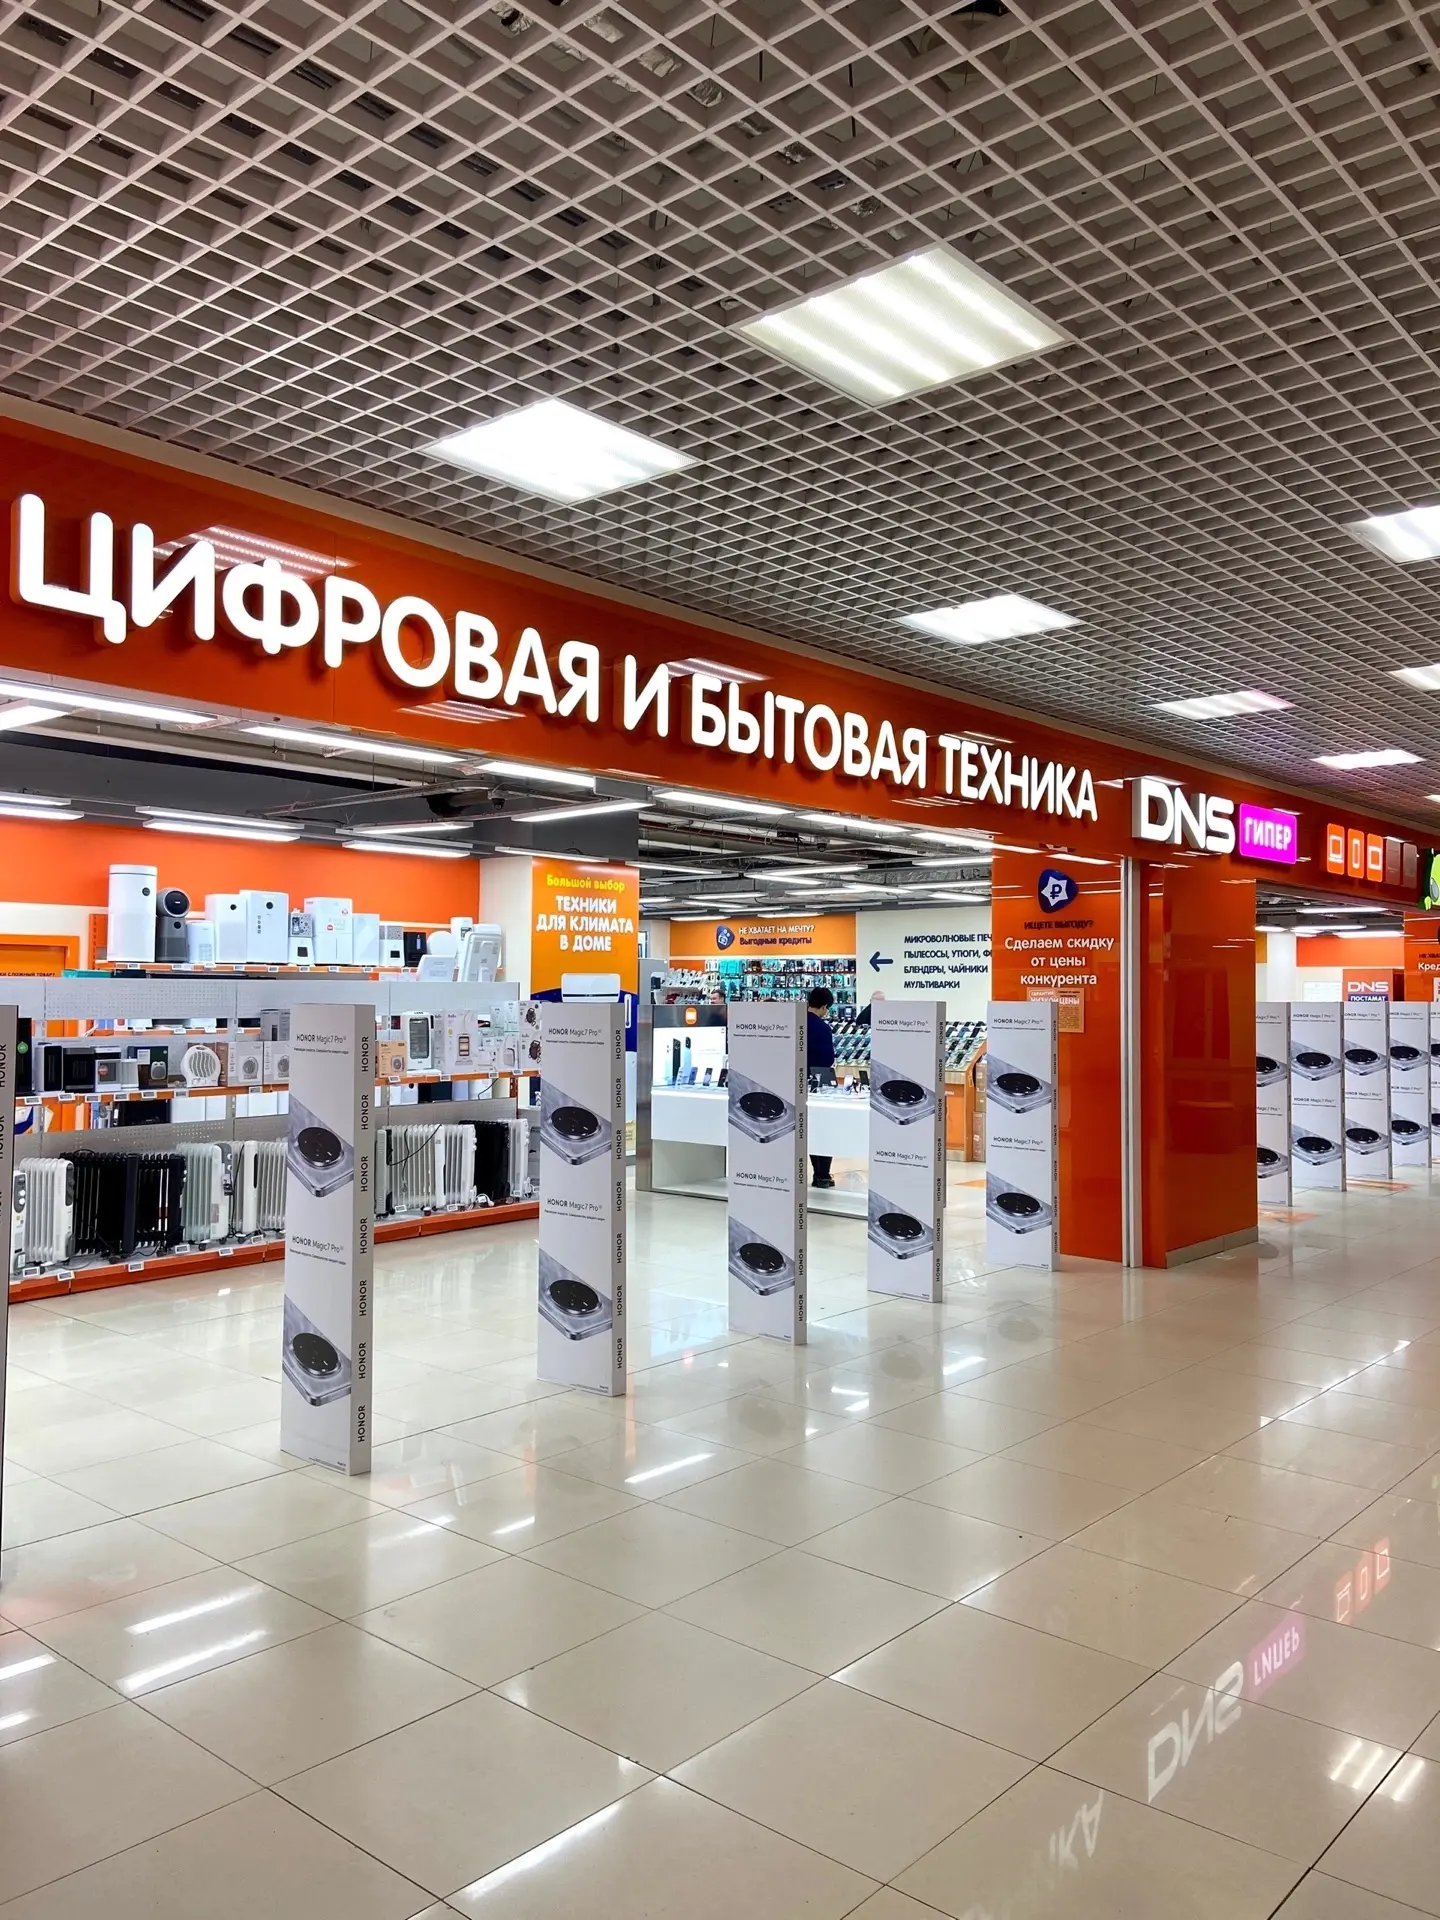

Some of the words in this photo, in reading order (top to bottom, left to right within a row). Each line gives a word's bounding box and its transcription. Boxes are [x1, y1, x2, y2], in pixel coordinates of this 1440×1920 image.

[17, 493, 600, 723] ЦИФРОВАЯ
[623, 654, 670, 738] И
[690, 673, 927, 789] БЫТОВАЯ
[938, 734, 1098, 822] ТЕХНИКА
[1138, 777, 1236, 854] DNS
[1244, 816, 1293, 851] ГИПЕР
[547, 874, 592, 888] Большой
[594, 879, 625, 893] выбор
[555, 895, 617, 914] ТЕХНИКИ
[536, 913, 567, 932] ДЛЯ
[569, 915, 634, 933] КЛИМАТА
[738, 926, 748, 934] НЕ
[748, 925, 776, 934] ХВАТАЕТ
[777, 925, 787, 933] НА
[788, 924, 815, 933] МЕЧТУ?
[559, 934, 569, 951] В
[572, 934, 612, 953] ДОМЕ
[739, 937, 777, 946] Выгодные
[778, 936, 813, 946] кредиты
[904, 933, 976, 944] МИКРОВОЛНОВЫЕ
[1005, 937, 1063, 951] Сделаем
[1066, 936, 1115, 951] скидку
[903, 949, 950, 960] ПЫЛЕСОСЫ,
[951, 949, 981, 959] УТЮГИ,
[1030, 957, 1046, 967] от
[1049, 956, 1086, 968] цены
[903, 965, 946, 975] БЛЕНДЕРЫ,
[903, 980, 960, 989] МУЛЬТИВАРКИ
[1020, 974, 1097, 988] конкурента
[1347, 981, 1389, 993] DNS
[297, 1033, 315, 1042] HONOR
[549, 1027, 569, 1036] HONOR
[361, 1155, 369, 1192] HONOR
[736, 1172, 757, 1180] HONOR
[547, 1198, 568, 1208] HONOR
[292, 1236, 311, 1246] HONOR
[360, 1217, 368, 1254] HONOR
[359, 1342, 367, 1380] HONOR
[358, 1404, 366, 1443] HONOR
